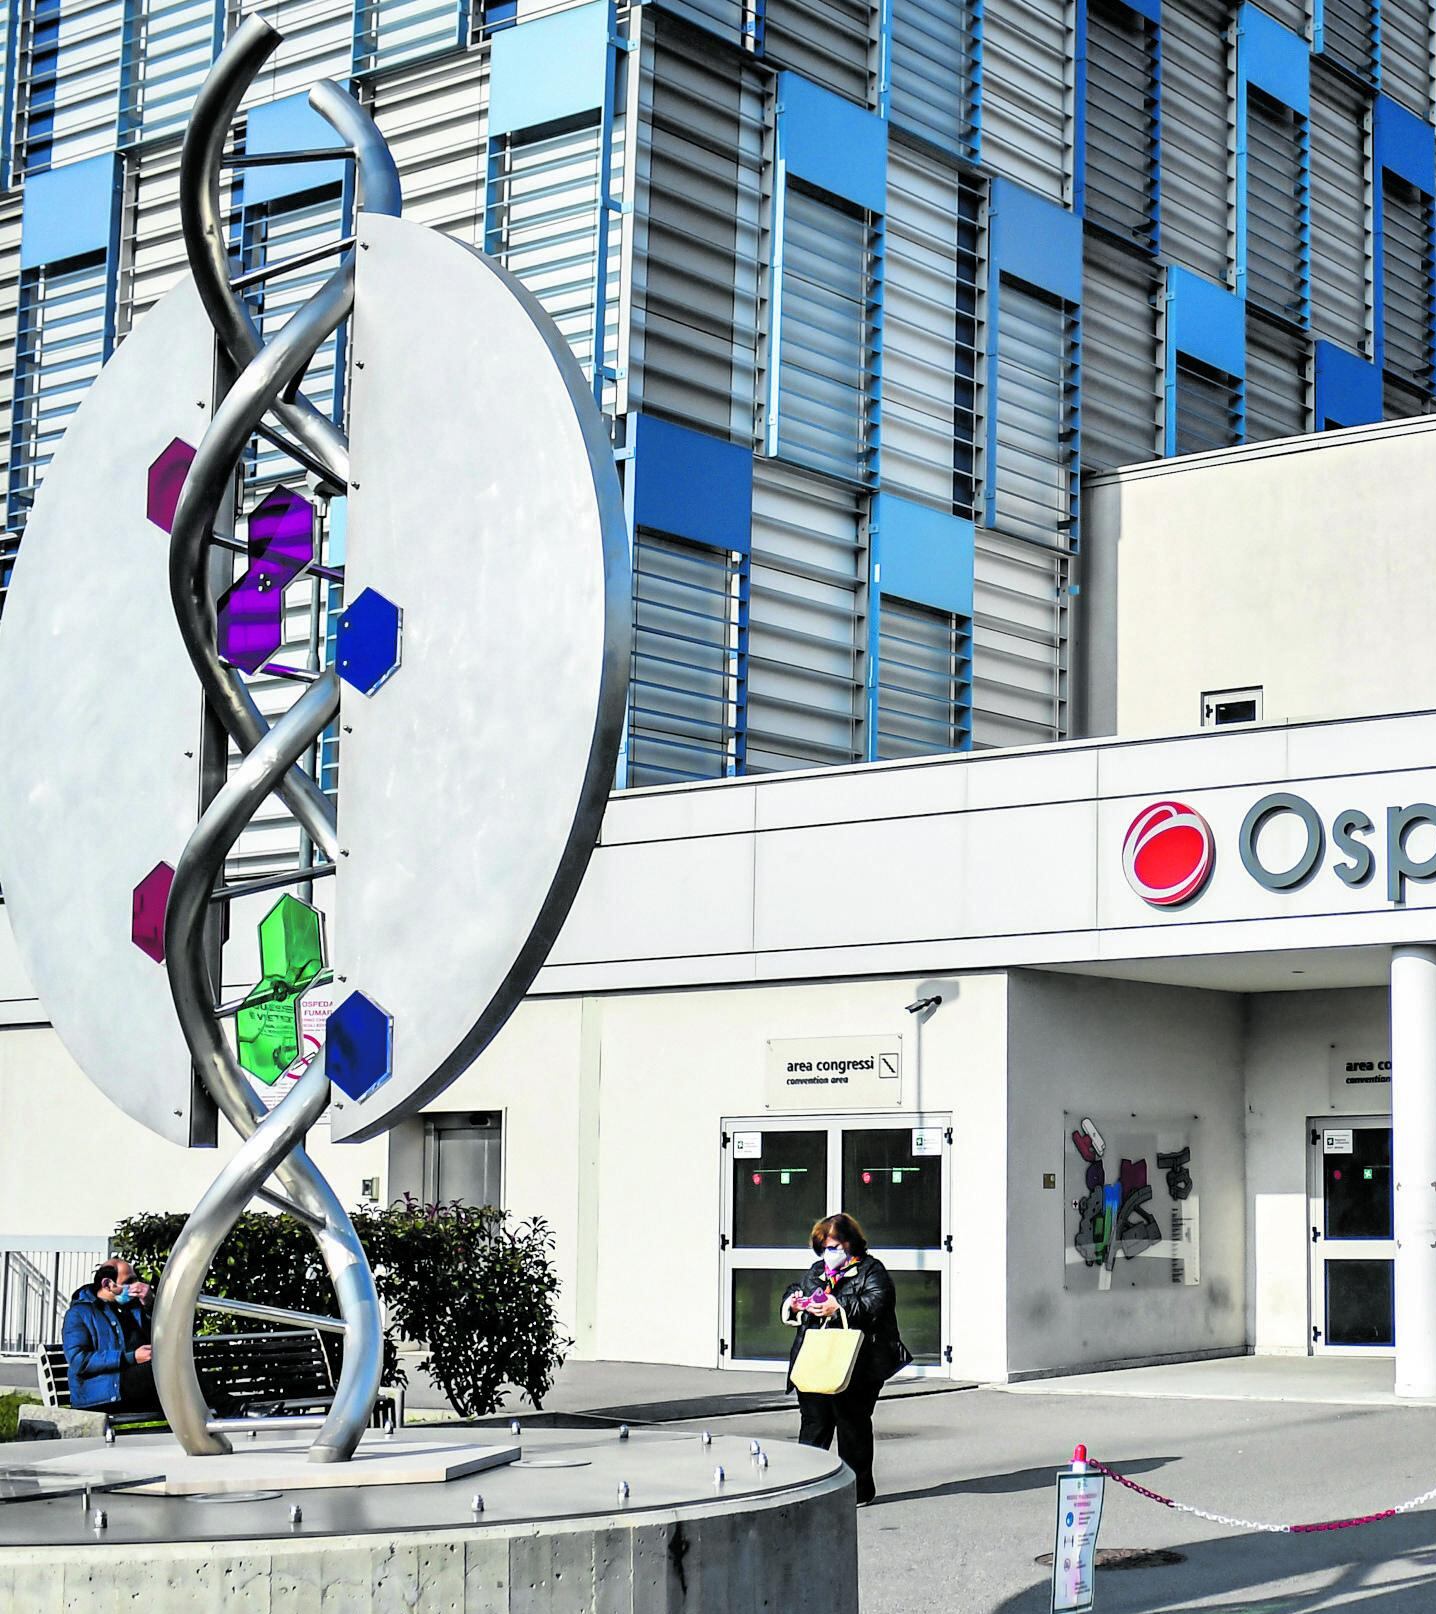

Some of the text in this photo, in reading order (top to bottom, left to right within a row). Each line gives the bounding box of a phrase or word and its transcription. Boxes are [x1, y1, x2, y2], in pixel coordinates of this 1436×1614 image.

[787, 1056, 874, 1075] area congressi
[1345, 1061, 1374, 1072] area
[786, 1076, 829, 1086] convention
